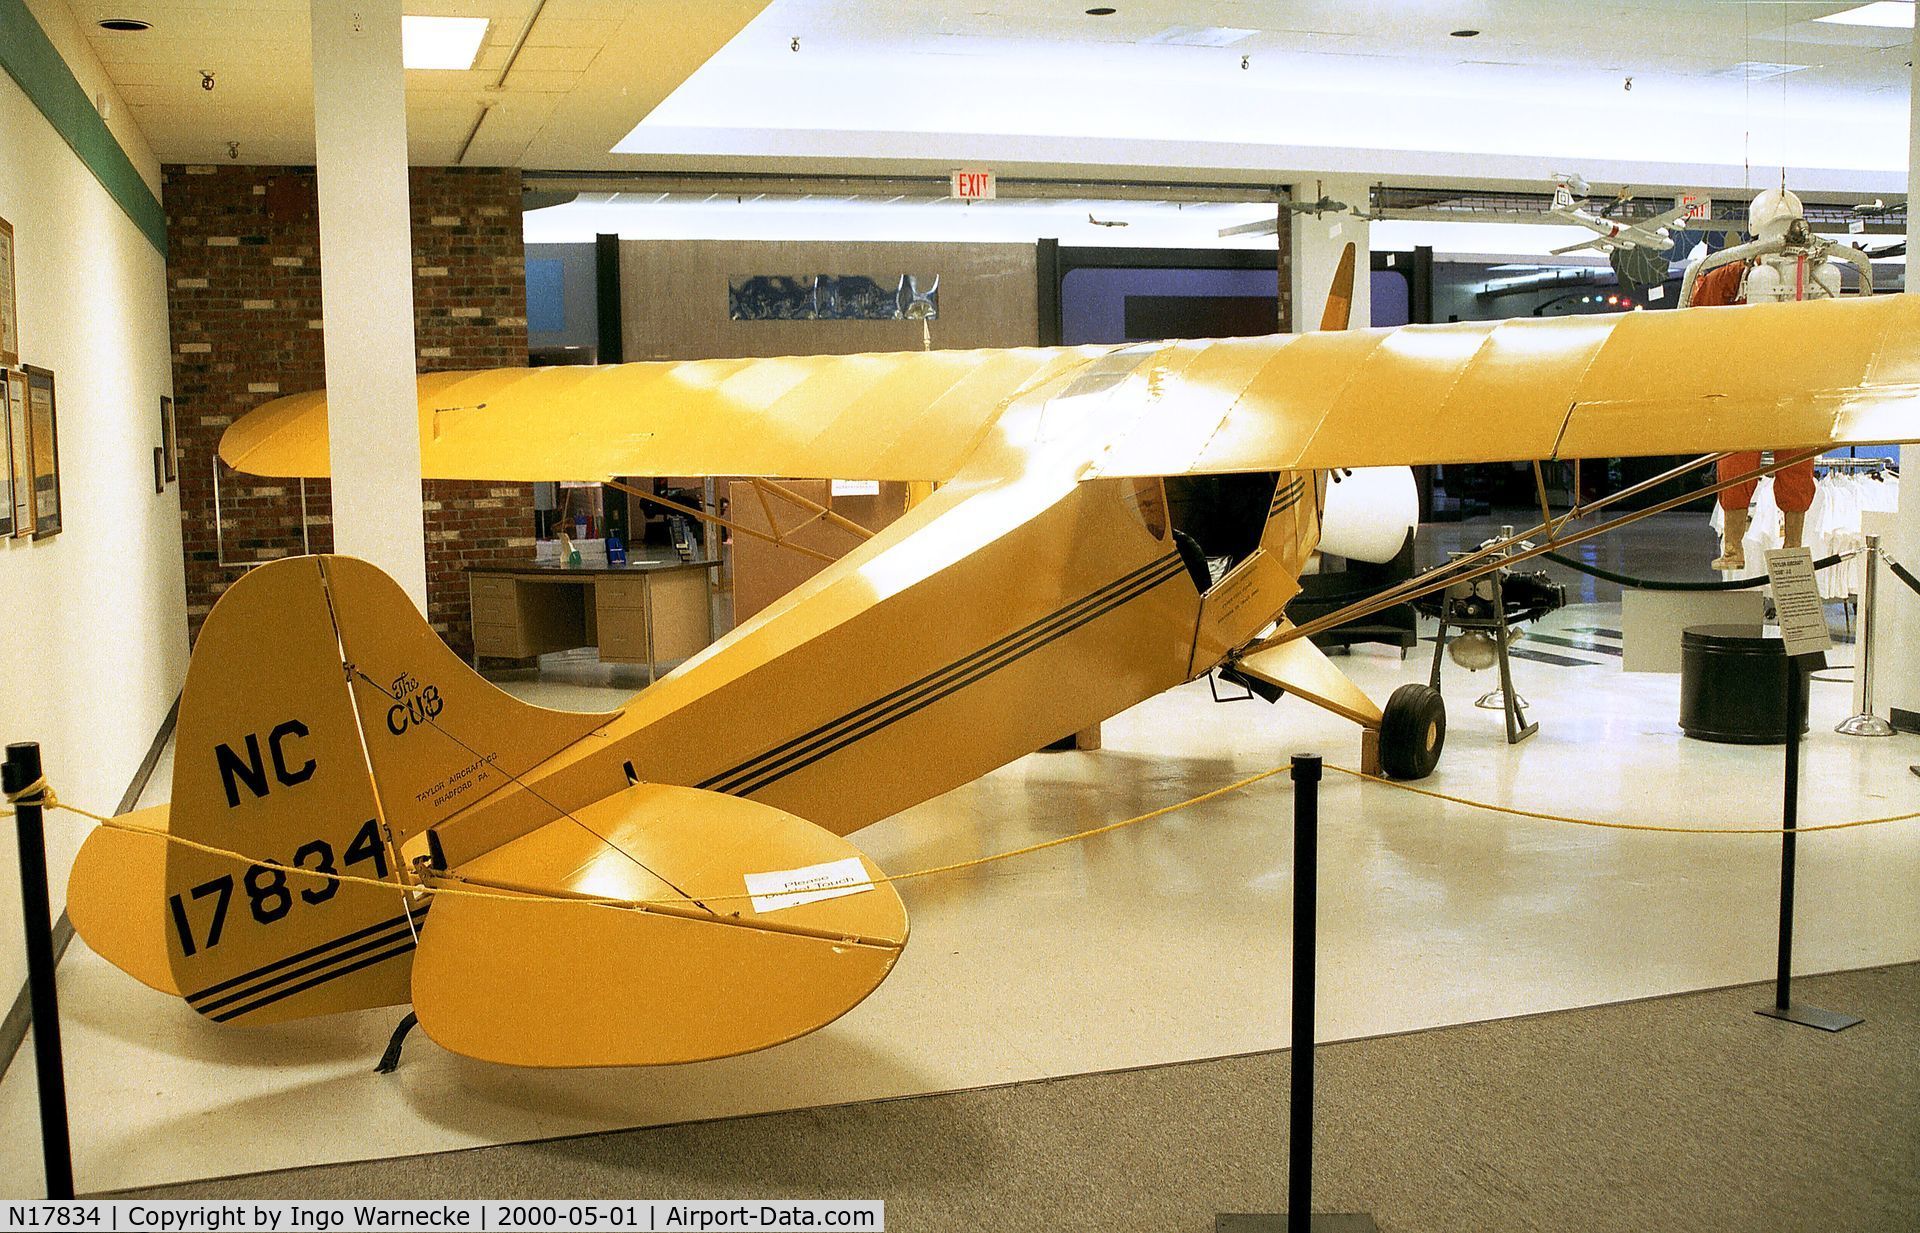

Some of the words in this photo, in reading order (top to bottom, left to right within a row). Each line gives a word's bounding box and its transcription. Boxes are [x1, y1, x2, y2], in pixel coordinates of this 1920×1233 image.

[959, 173, 989, 197] EXIT
[392, 671, 420, 699] The
[387, 685, 444, 736] CUB
[214, 719, 318, 809] NC
[415, 781, 446, 803] TAYLOR
[448, 760, 485, 785] AIRCRAFT
[434, 779, 473, 807] BRADFORD
[168, 817, 389, 958] 17834
[784, 875, 829, 889] Please
[816, 876, 855, 889] Touch
